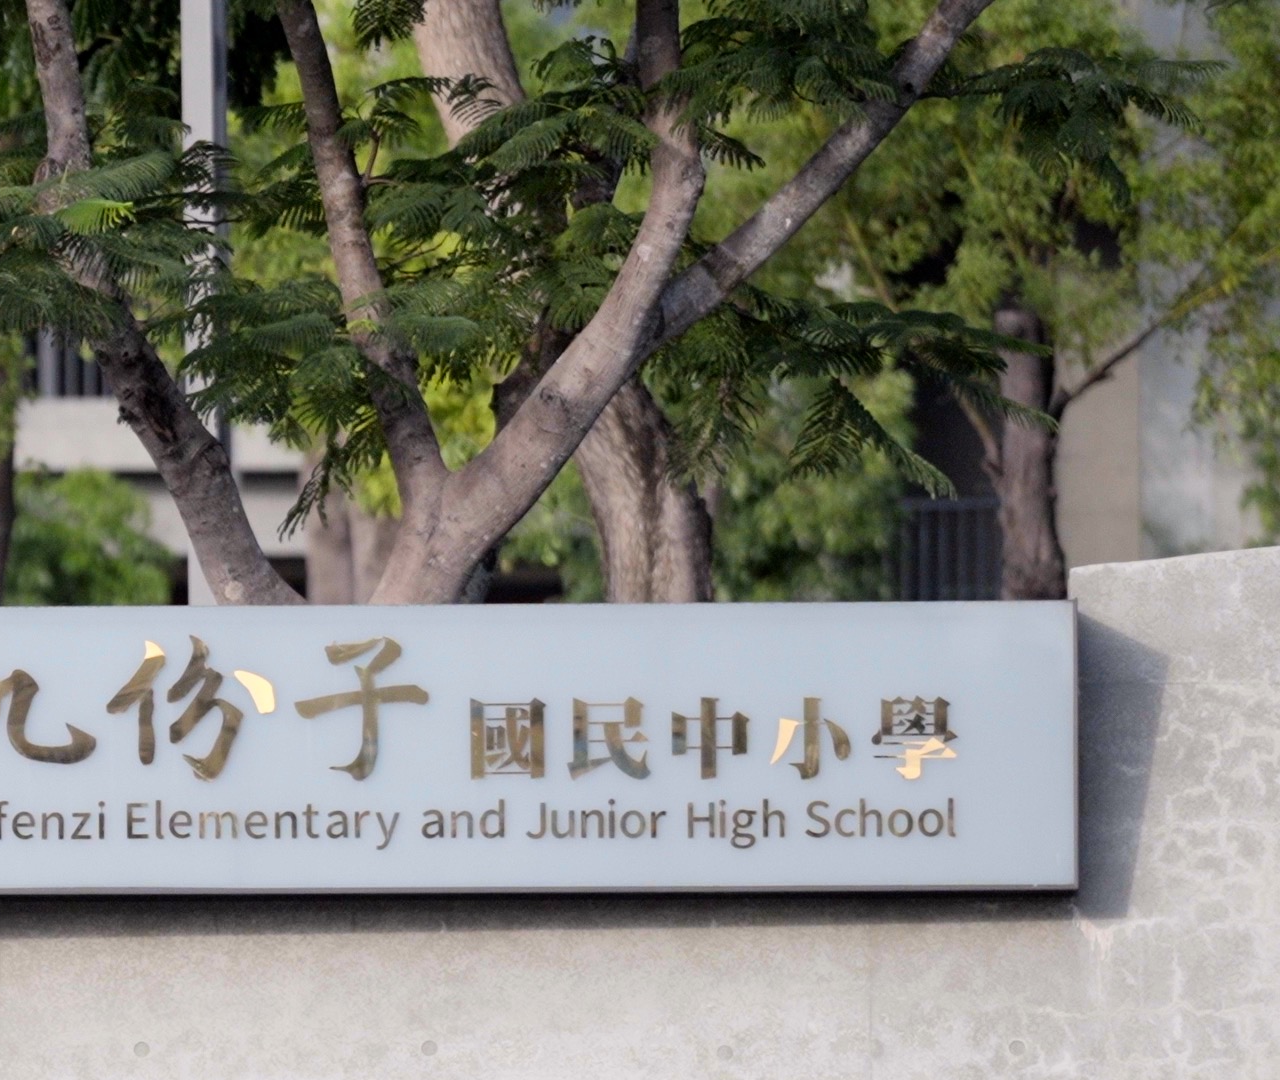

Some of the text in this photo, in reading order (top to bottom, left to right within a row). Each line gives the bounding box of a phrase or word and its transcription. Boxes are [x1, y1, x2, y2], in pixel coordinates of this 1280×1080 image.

[126, 799, 400, 851] Elementary
[421, 798, 506, 841] and
[525, 798, 668, 841] Junior
[687, 798, 786, 850] High
[804, 797, 957, 840] School
